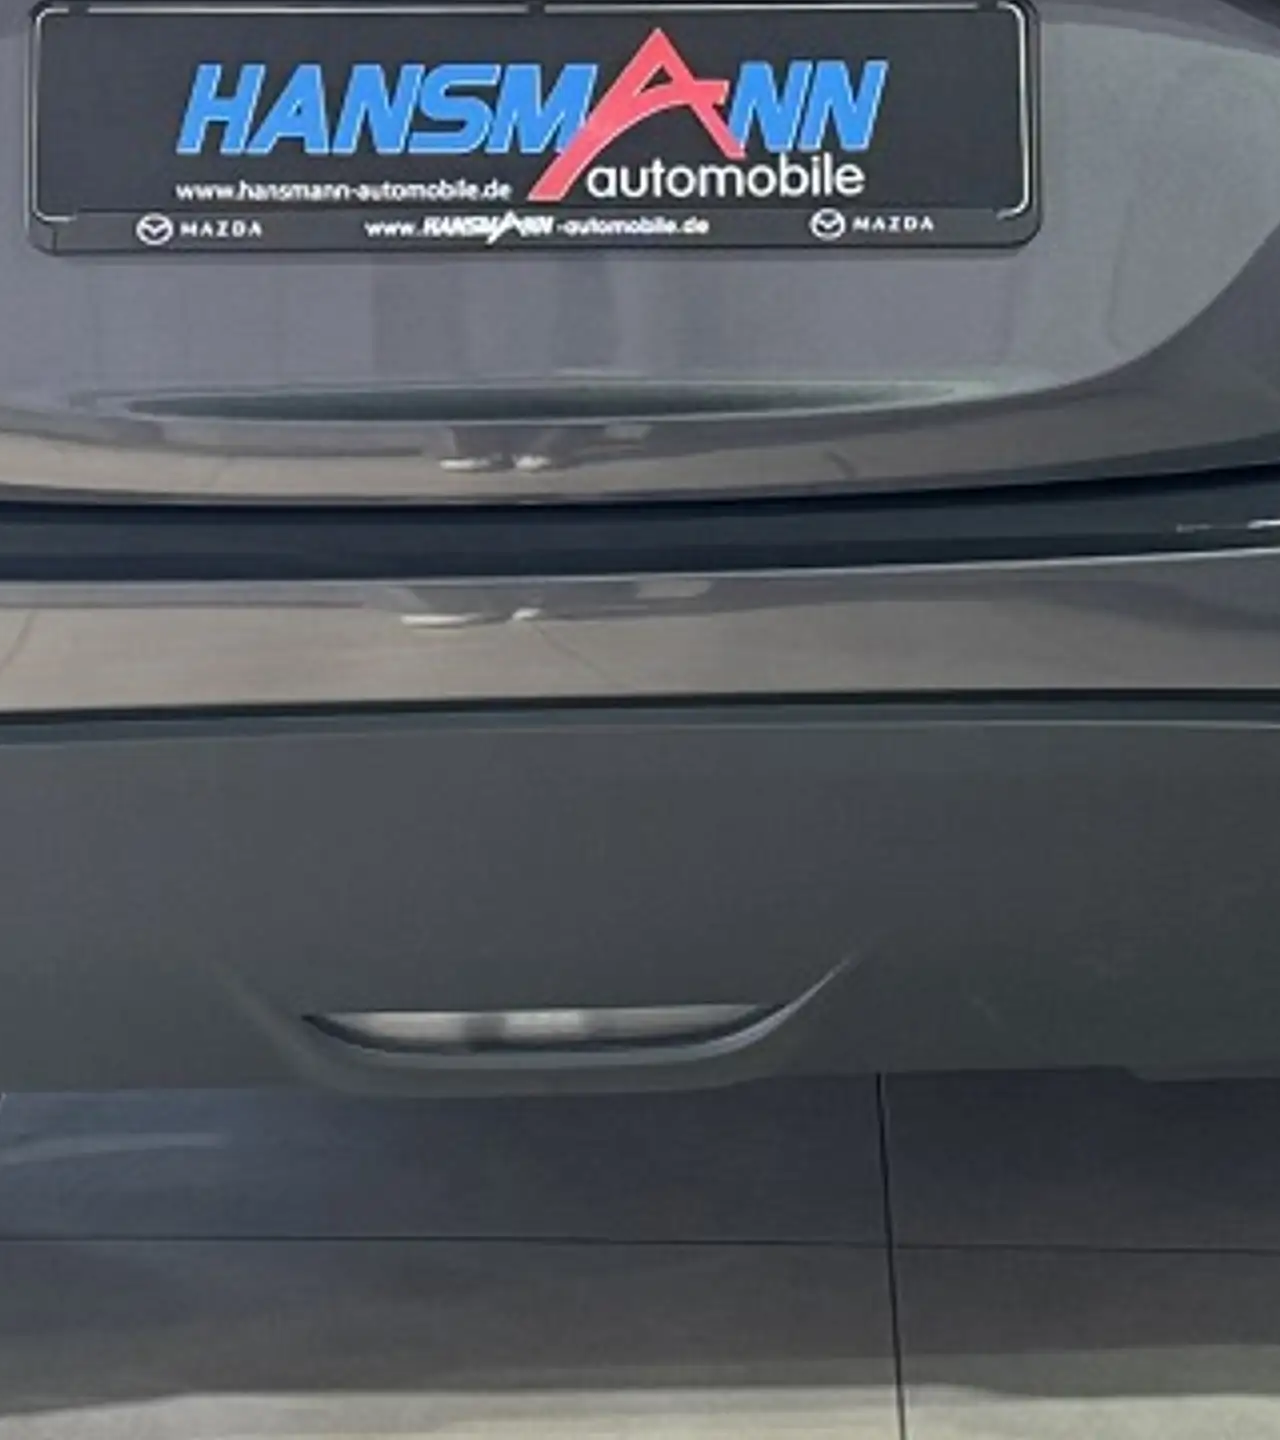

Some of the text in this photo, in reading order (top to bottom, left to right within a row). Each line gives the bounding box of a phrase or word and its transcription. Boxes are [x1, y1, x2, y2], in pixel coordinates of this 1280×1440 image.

[176, 28, 888, 202] HANSMANN
[586, 154, 866, 198] automobile
[176, 178, 512, 201] www.hansmann-automobile.de
[180, 220, 263, 238] MAZDA
[851, 217, 935, 233] MAZDA
